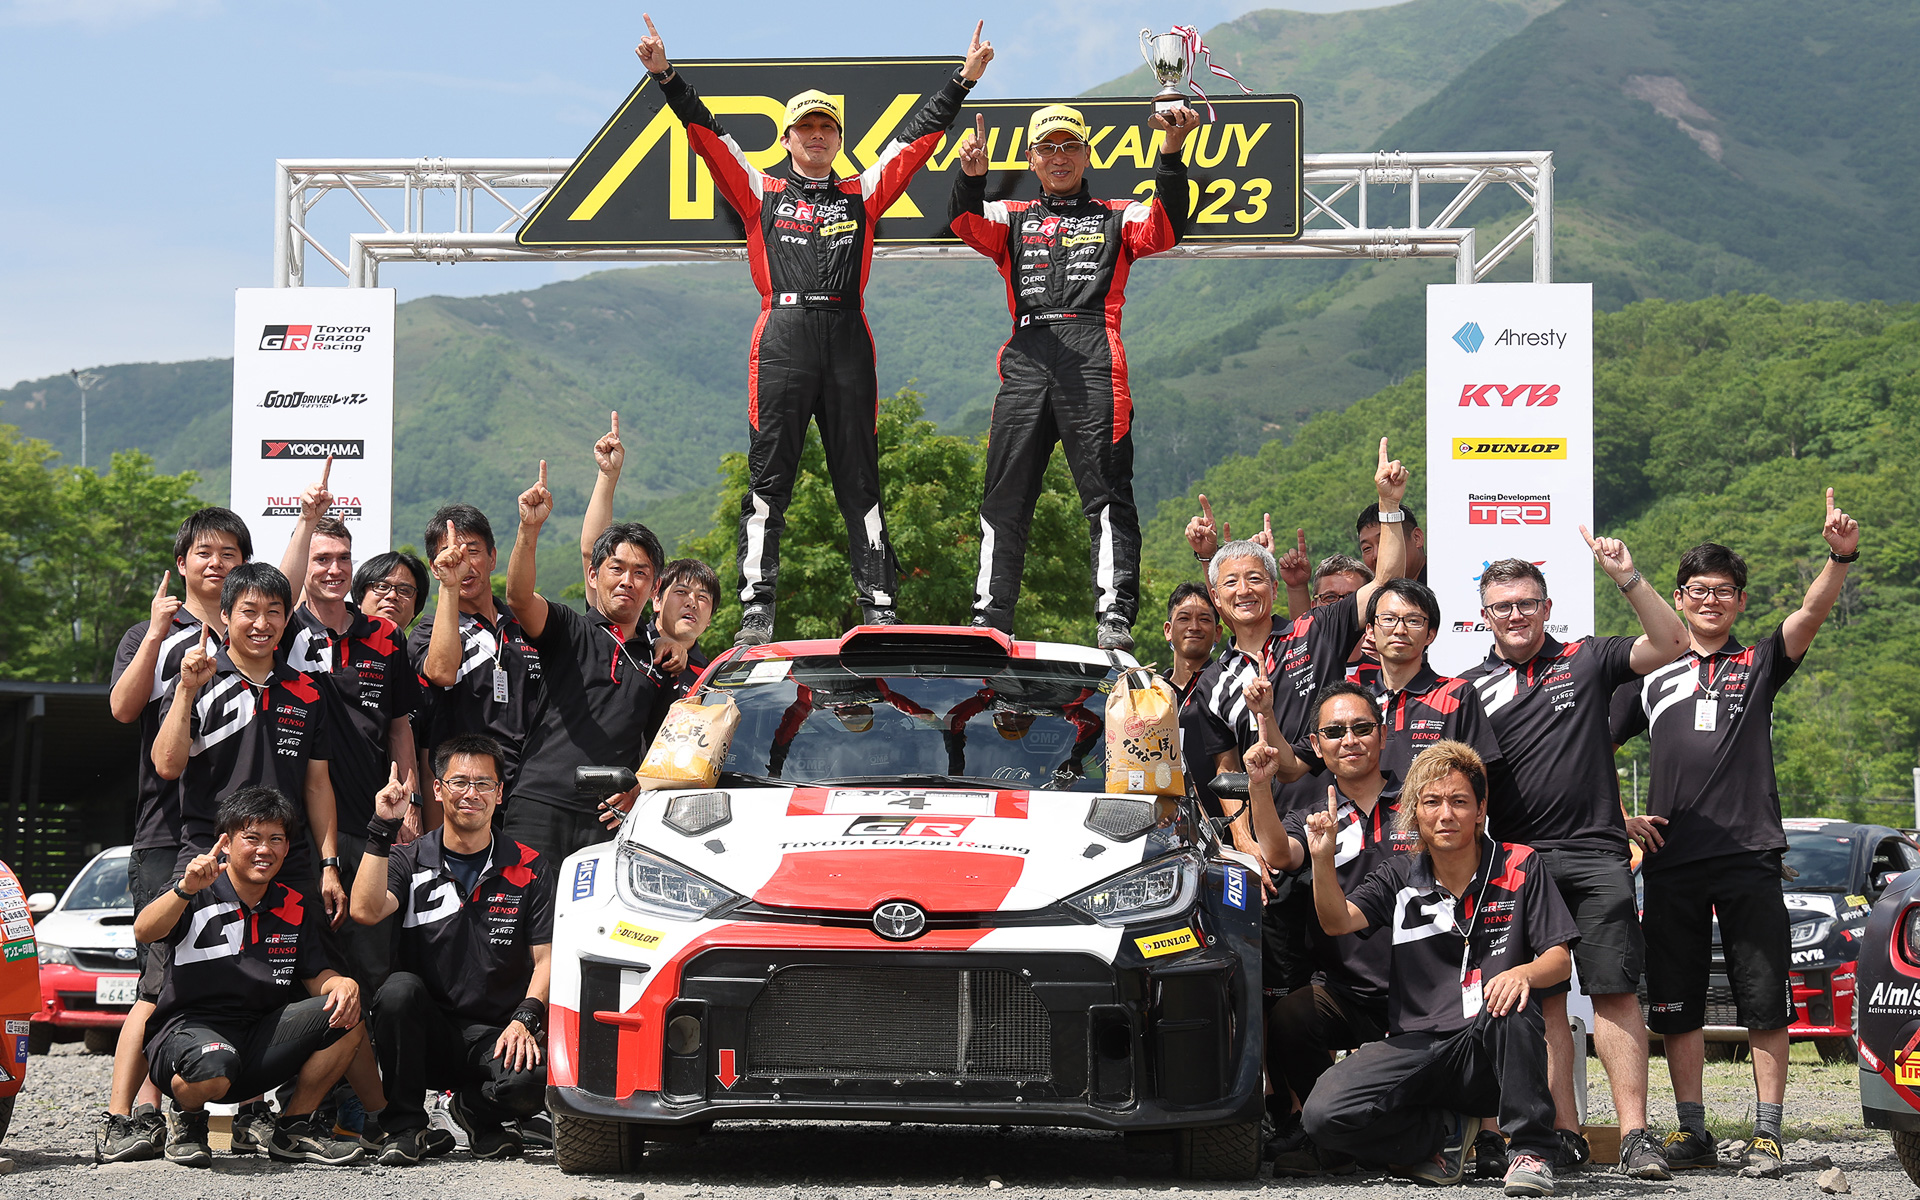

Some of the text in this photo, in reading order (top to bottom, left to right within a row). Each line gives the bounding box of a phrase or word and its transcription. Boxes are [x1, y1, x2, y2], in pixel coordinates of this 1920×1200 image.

[797, 99, 837, 111] DUNLOP
[1041, 115, 1082, 126] DUNLOP
[924, 122, 1272, 172] RALL KAMUY
[1131, 177, 1273, 225] 223
[776, 199, 813, 221] GR
[774, 219, 814, 233] DENSO
[828, 223, 855, 233] DUNLOP
[1021, 214, 1104, 237] GR TOYOTA
[780, 235, 808, 245] KYB
[1021, 235, 1056, 248] DENSO
[1024, 249, 1050, 257] KYB
[1068, 245, 1097, 259] SANGO
[260, 325, 371, 350] GR TOYOTA
[314, 334, 365, 342] GAZOO
[1494, 328, 1567, 350] Ahresty
[312, 342, 362, 352] Racing
[1458, 384, 1561, 407] KYB
[288, 443, 361, 456] YOKOHAMA
[1474, 443, 1560, 453] DUNLOP
[267, 496, 362, 506] NUTRA
[1468, 493, 1551, 502] Racing Development
[1470, 503, 1549, 525] TRD
[1453, 623, 1474, 633] GR
[1285, 654, 1311, 671] DENSO
[358, 671, 384, 680] DENSO
[1542, 672, 1572, 686] DENSO
[1724, 683, 1747, 691] DENS
[1550, 689, 1575, 704] SANGO
[276, 706, 292, 714] GR
[277, 716, 305, 728] DENSO
[1410, 722, 1427, 730] GR
[1029, 733, 1060, 744] OMP
[1411, 732, 1441, 740] DENSO
[1122, 733, 1178, 763] ななつぼし
[888, 797, 932, 810] 4
[845, 818, 970, 837] GR
[778, 838, 1031, 855] TOYOTA GAZOO Racing
[575, 860, 595, 898] AISIN
[1226, 866, 1243, 908] AISIN
[488, 905, 519, 915] DENSO
[1481, 905, 1497, 913] GR
[1483, 913, 1514, 924] DENSO
[488, 926, 516, 936] SANGO
[620, 927, 659, 944] DUNLOP
[1152, 933, 1192, 950] DUNLOP
[267, 946, 297, 955] DENSO
[1791, 948, 1826, 965] KYB
[272, 966, 295, 977] SANGO
[108, 989, 138, 1002] 64-5
[1860, 1044, 1879, 1069] MOTUL
